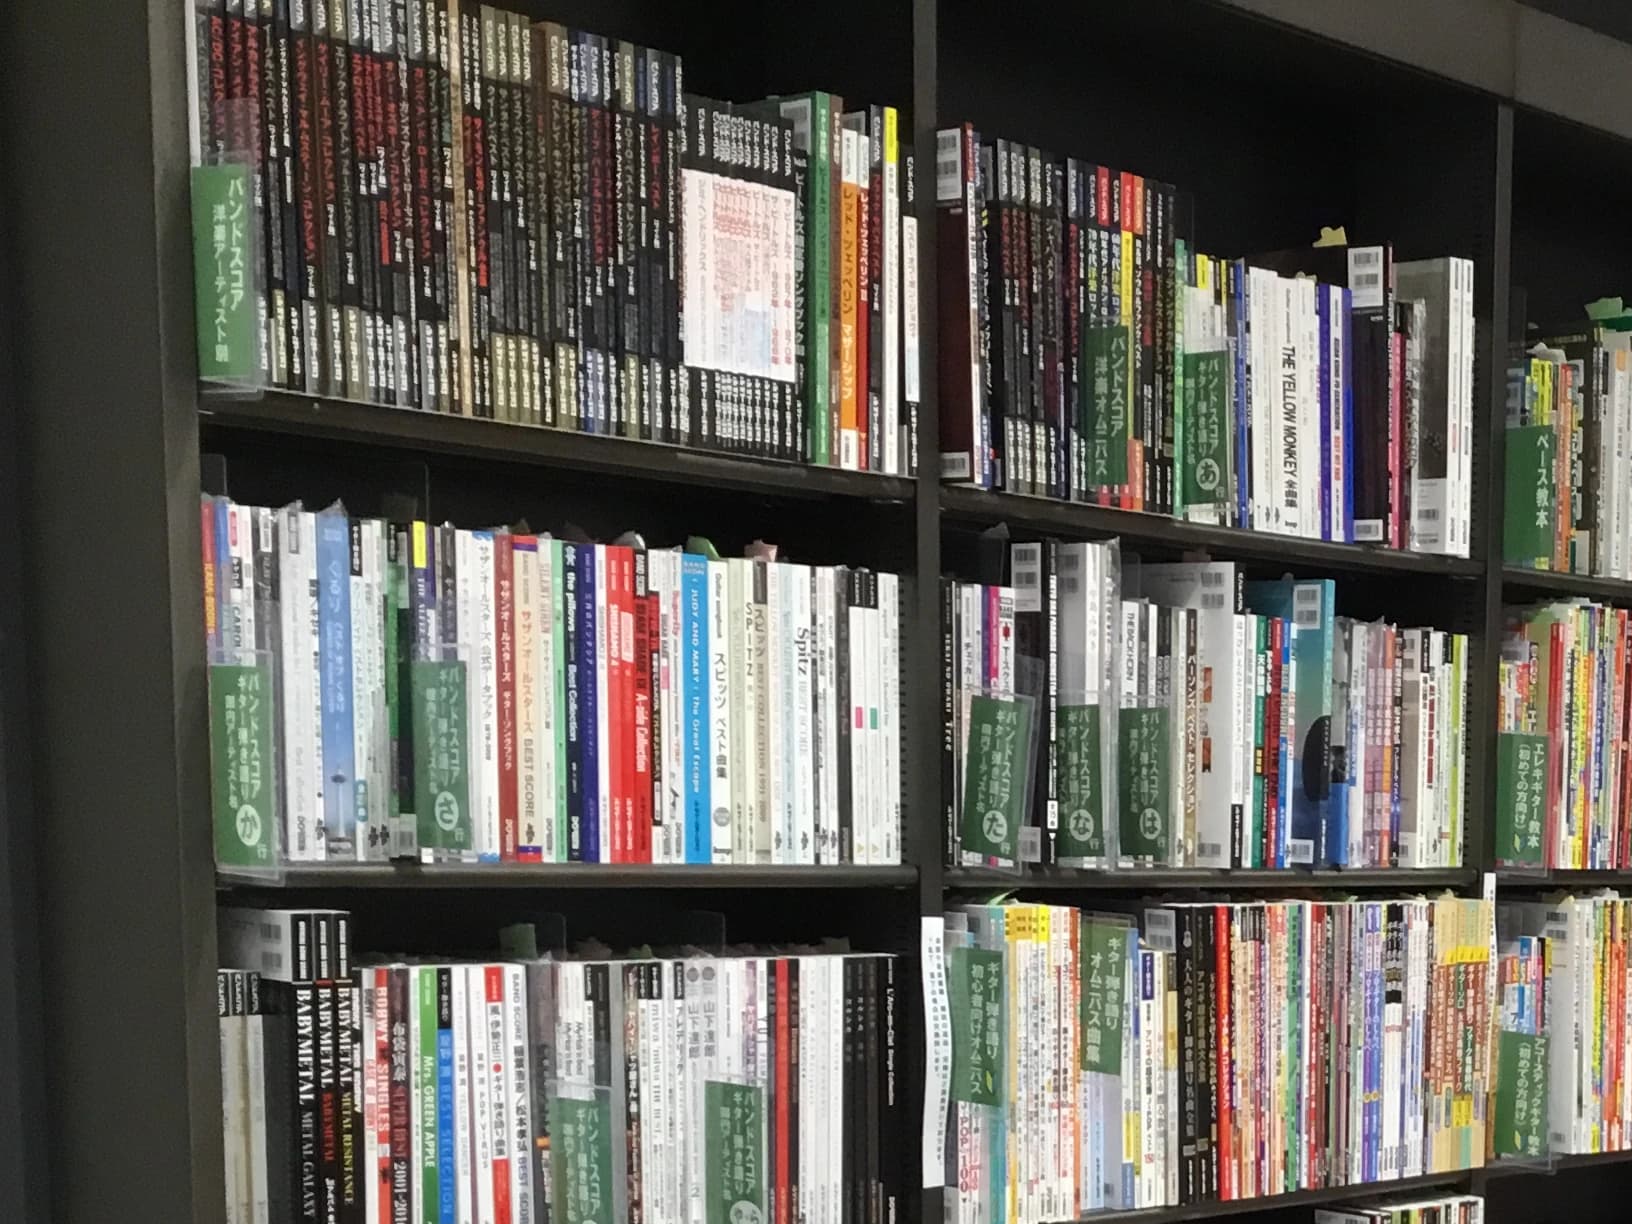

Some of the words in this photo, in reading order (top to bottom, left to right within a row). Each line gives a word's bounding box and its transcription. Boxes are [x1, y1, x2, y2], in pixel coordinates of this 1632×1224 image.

[228, 178, 244, 312] バンドスコア
[1112, 336, 1127, 437] バンドスコア
[1282, 346, 1296, 369] THE
[1282, 371, 1297, 424] YELLOW
[1095, 356, 1110, 475] 洋楽オムニバス
[1208, 359, 1219, 451] バンドスコア
[1283, 425, 1298, 478] MONKEY
[1536, 434, 1548, 528] ベース教本
[567, 590, 575, 631] pillows
[568, 664, 576, 688] Best
[569, 690, 577, 741] Collection
[712, 653, 726, 710] スピッツ
[247, 674, 261, 799] バンドスコア
[449, 667, 460, 786] バンドスコア
[524, 739, 533, 770] BEST
[715, 717, 728, 779] ベスト曲集
[1001, 709, 1017, 808] バンドスコア
[1079, 709, 1091, 805] バンドスコア
[1149, 708, 1158, 803] バンドスコア
[525, 772, 534, 817] SCORE
[1527, 743, 1545, 849] エレキギター教本
[970, 963, 983, 1094] 初心者向けオムニバス
[986, 962, 1000, 1060] ギター弾き語り
[1087, 953, 1102, 1064] オムニバス曲集
[1105, 938, 1121, 1031] ギター弾き語り
[296, 989, 314, 1105] BABYMETAL
[318, 988, 334, 1088] BABYMETAL
[337, 988, 352, 1087] BABYMETAL
[423, 1056, 433, 1084] Mrs.
[423, 1086, 434, 1127] GREEN
[424, 1129, 435, 1168] APPLE
[744, 1091, 755, 1194] バンドスコア
[303, 1161, 314, 1217] GALAXY
[587, 1107, 600, 1216] バンドスコア
